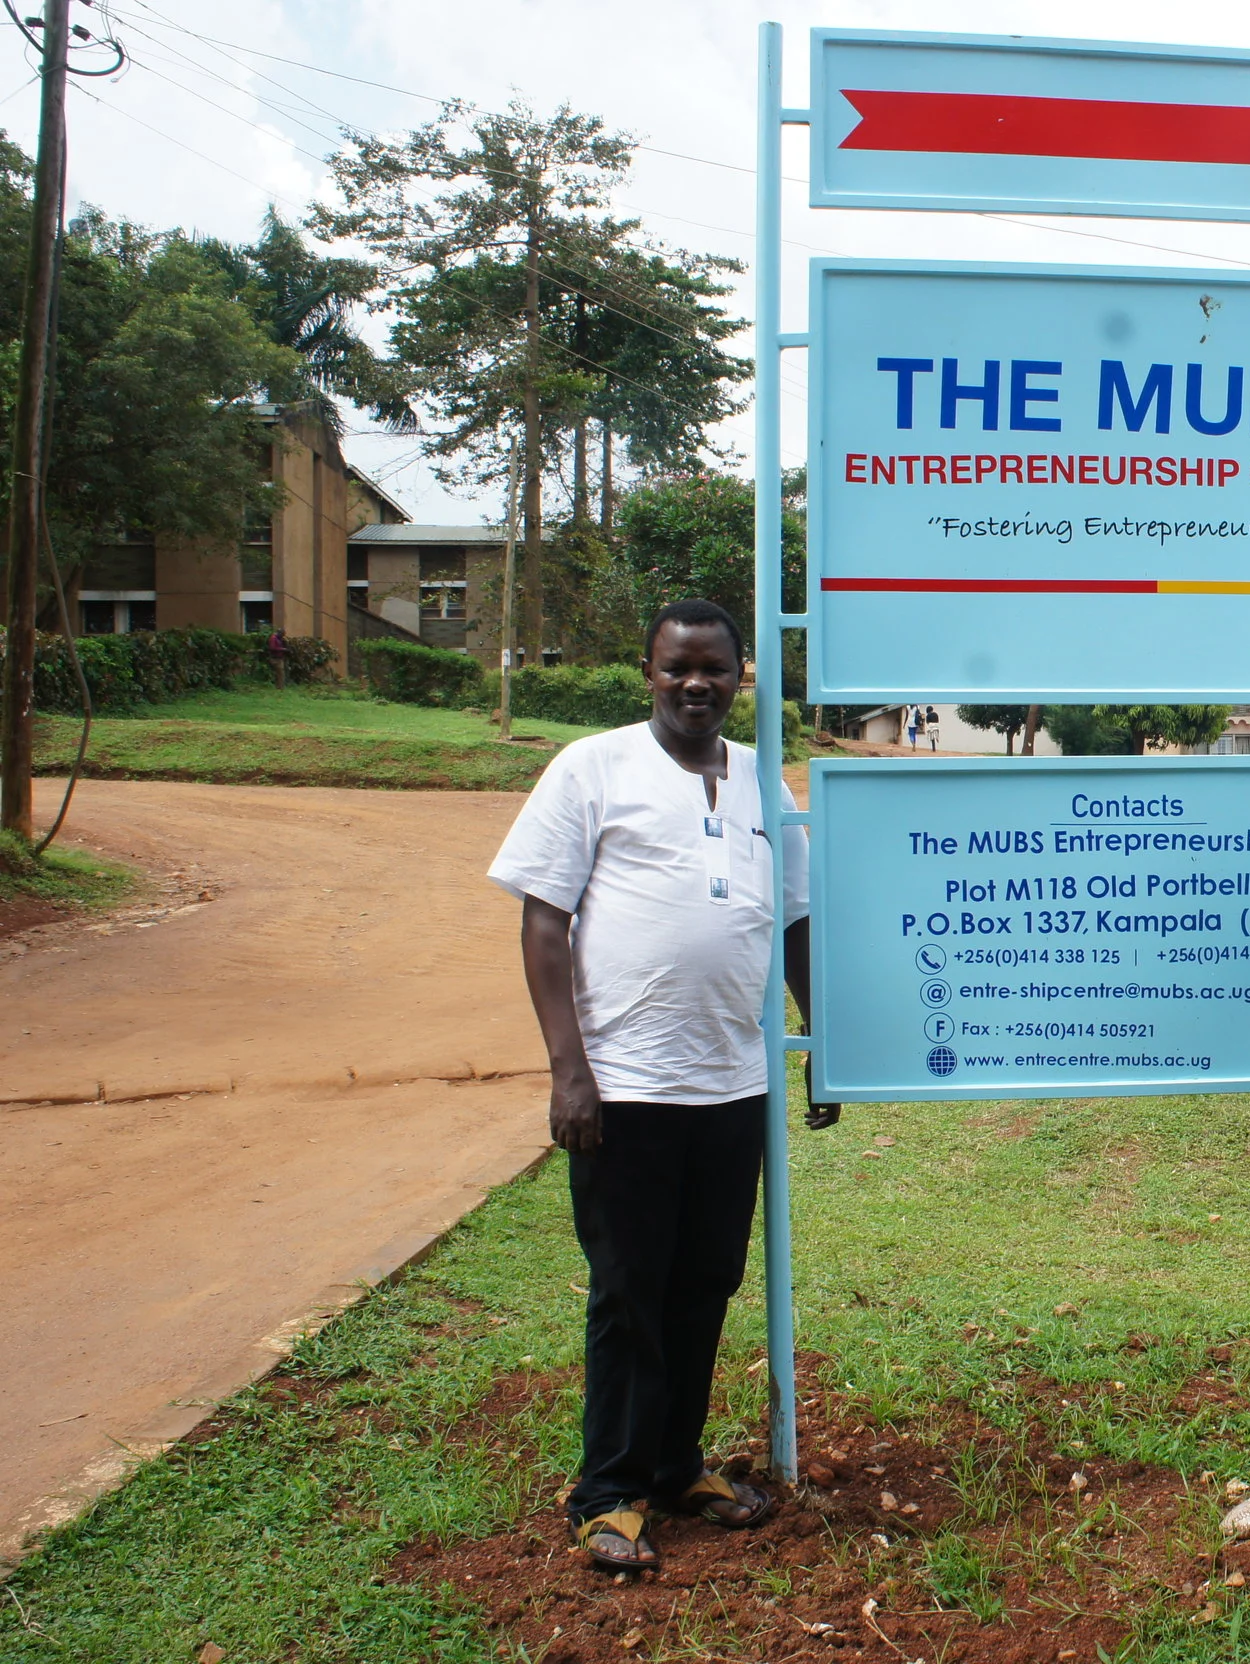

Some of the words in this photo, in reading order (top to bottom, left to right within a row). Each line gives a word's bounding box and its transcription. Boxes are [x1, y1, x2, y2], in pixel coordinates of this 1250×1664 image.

[876, 357, 1063, 433] THE
[845, 453, 1240, 488] ENTREPRENEURSHIP
[928, 511, 1073, 544] “Fostering
[1071, 793, 1184, 818] Contacts
[908, 831, 958, 855] The
[967, 830, 1044, 854] MUBS
[946, 879, 997, 903] Plot
[1005, 876, 1077, 902] M118
[1086, 874, 1136, 899] Old
[1147, 872, 1250, 897] Portbell
[902, 912, 1012, 937] P.O.Box
[1023, 910, 1089, 936] 1337,
[1096, 908, 1222, 938] Kampala
[953, 948, 1049, 968] +256(0)414
[1054, 948, 1085, 964] 338
[1091, 948, 1121, 965] 125
[1156, 945, 1250, 965] +256(0)414
[936, 1020, 946, 1038] F
[961, 1021, 990, 1036] Fax
[1005, 1022, 1095, 1040] +256(0)414
[1099, 1023, 1154, 1038] 505921
[963, 1055, 1009, 1067] www.
[1014, 1052, 1211, 1071] entrecentre.mubs.ac.ug
